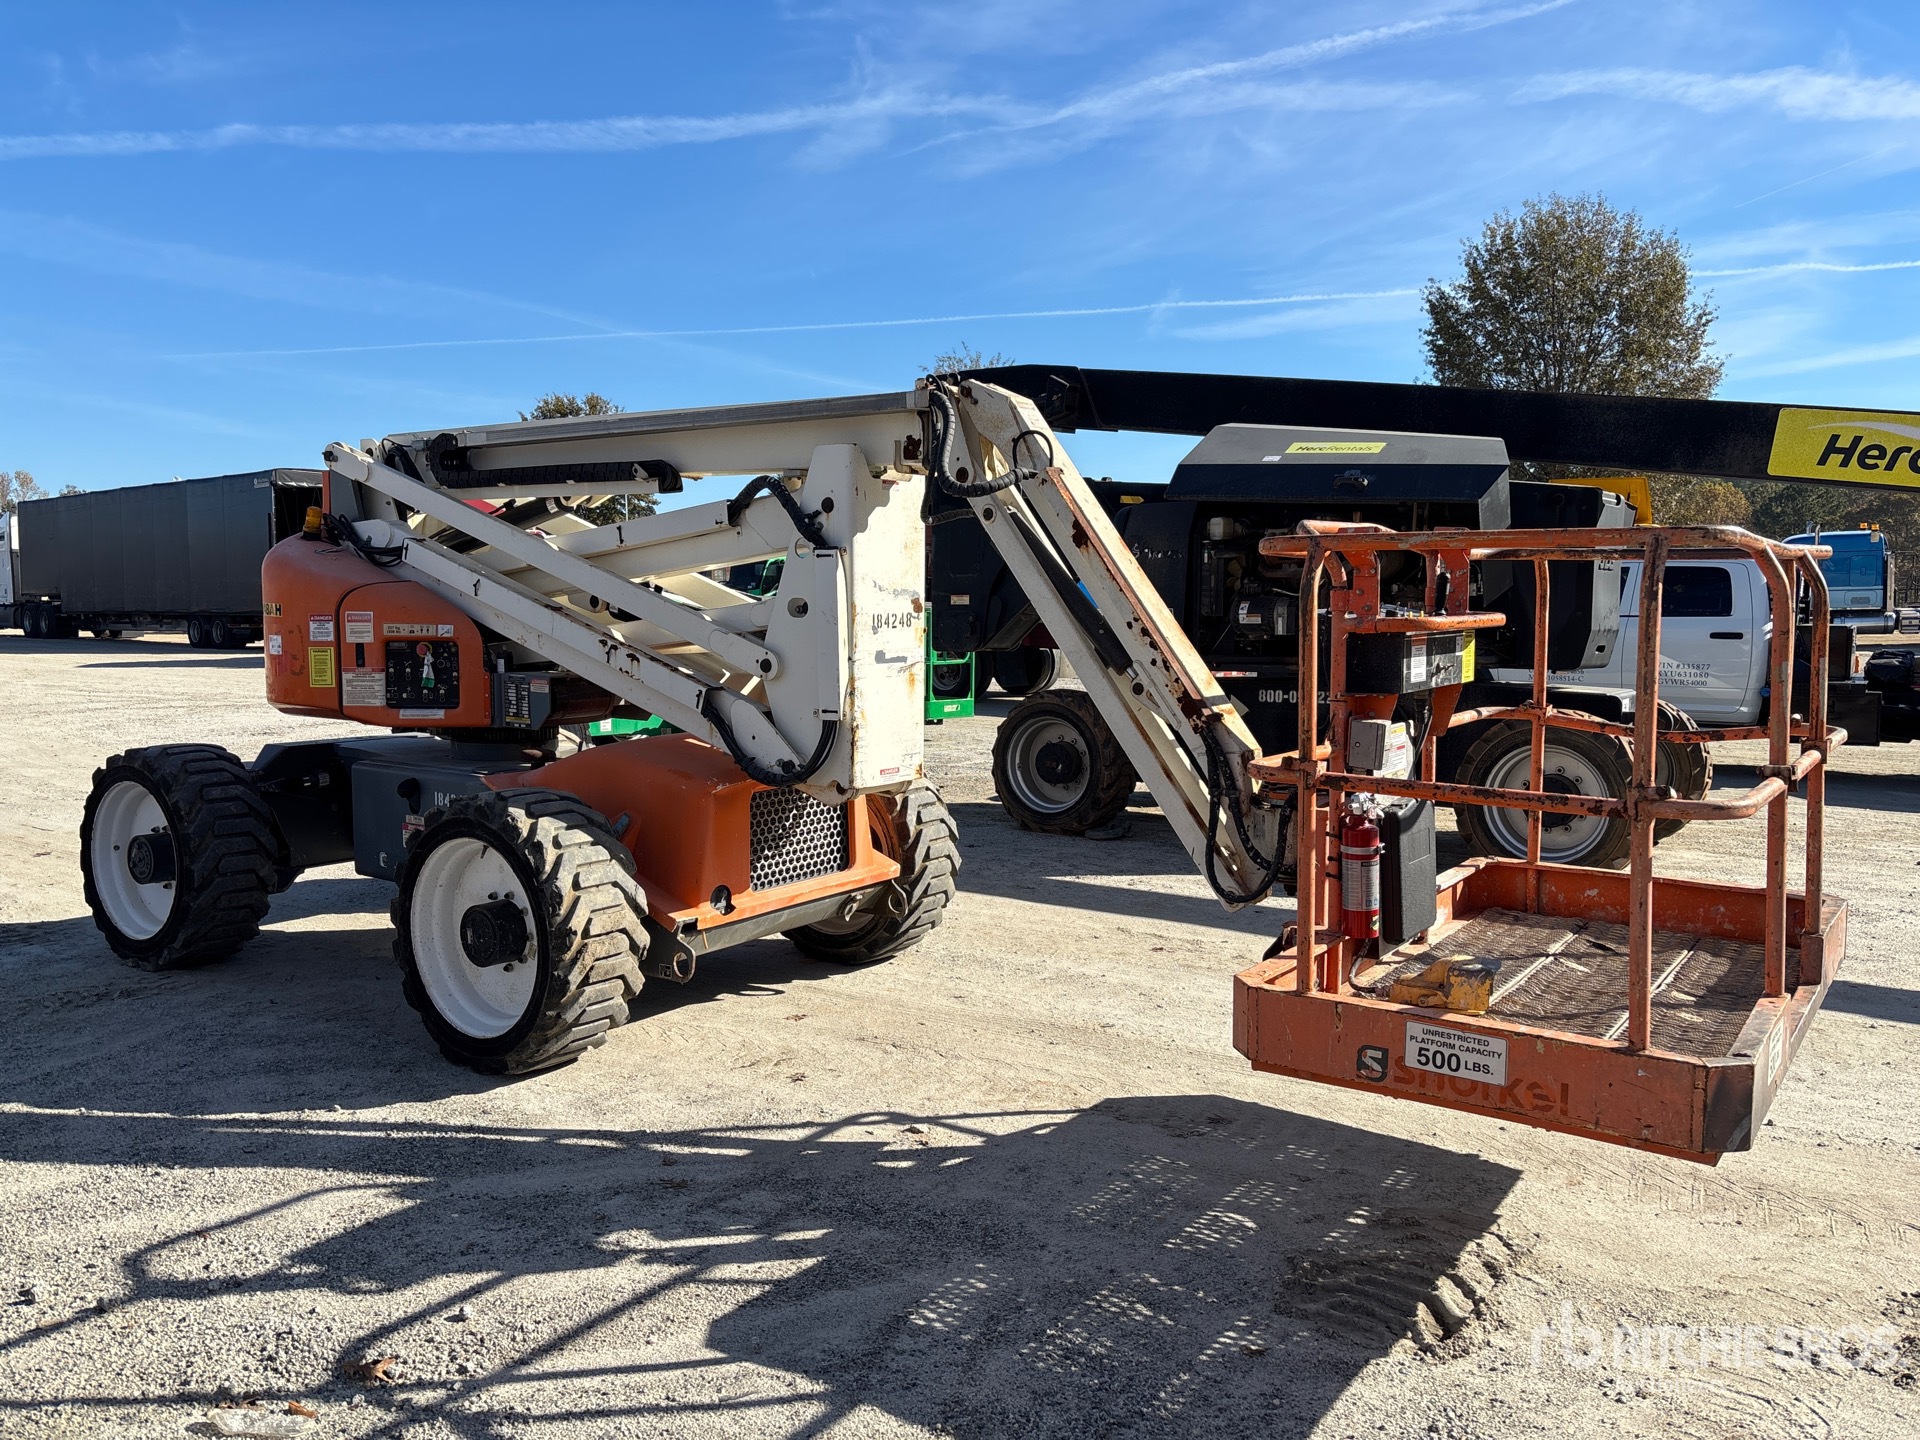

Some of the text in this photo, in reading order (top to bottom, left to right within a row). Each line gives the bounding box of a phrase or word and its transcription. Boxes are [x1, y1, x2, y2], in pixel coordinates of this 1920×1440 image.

[1409, 1035, 1503, 1060] PLATFORM CAPACITY
[1422, 1027, 1490, 1047] UNRESTRICTED
[1416, 1046, 1494, 1076] 500 LBS.
